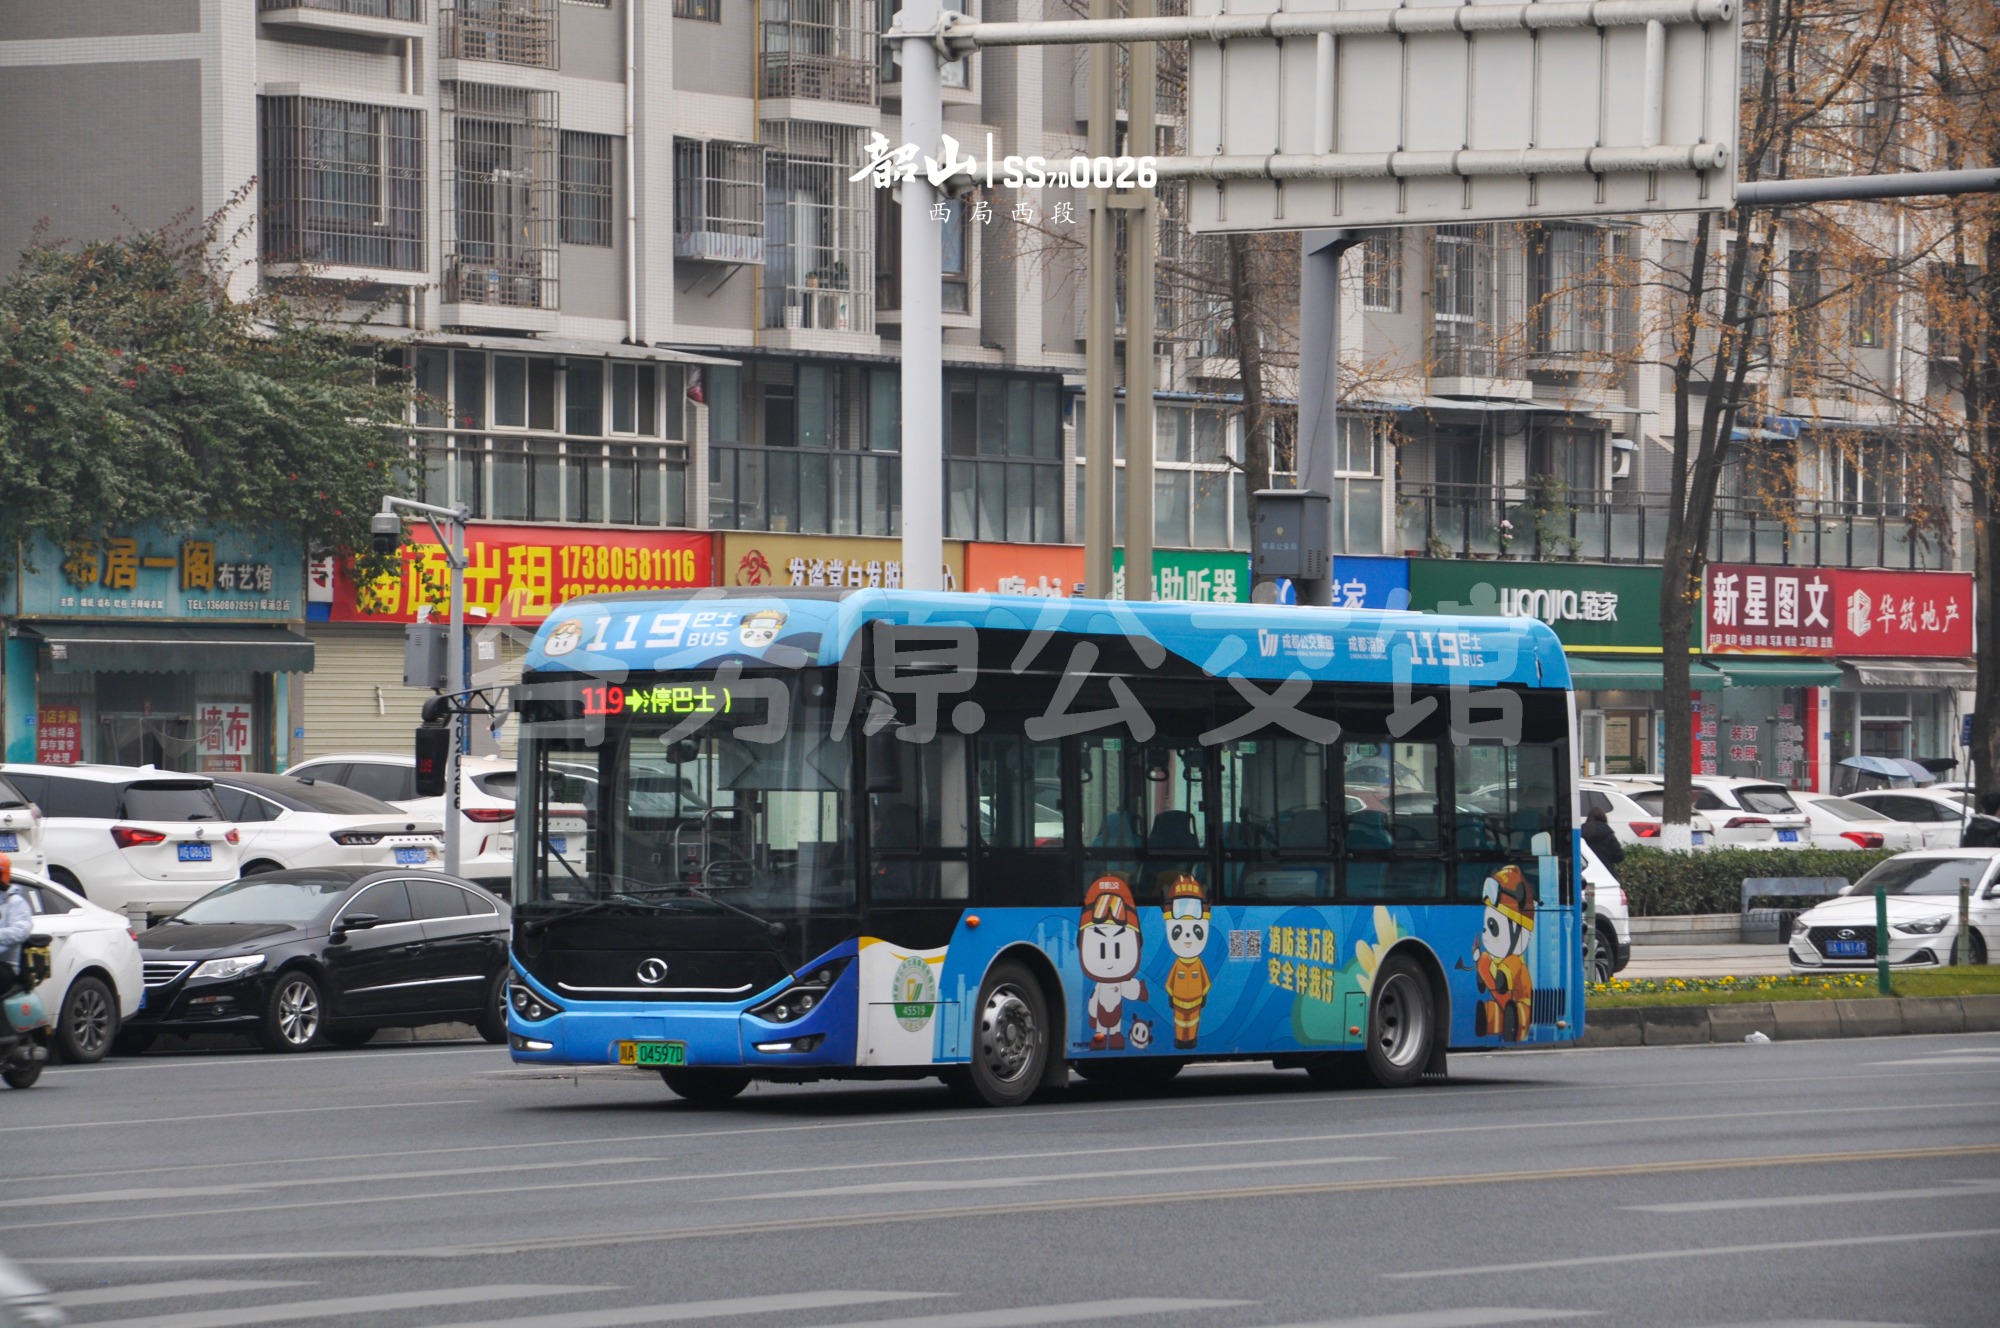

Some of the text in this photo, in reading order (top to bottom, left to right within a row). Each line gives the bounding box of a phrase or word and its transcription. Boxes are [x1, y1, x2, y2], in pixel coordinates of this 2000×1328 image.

[218, 564, 272, 591] 布艺馆
[354, 542, 551, 618] 铺面出租
[559, 546, 695, 582] 17380581116
[1713, 572, 1829, 629] 新星图文
[1876, 594, 1959, 634] 华筑地产
[586, 611, 737, 651] 119 巴士
[686, 631, 730, 647] BUS
[1407, 631, 1482, 666] 119 巴士
[1462, 653, 1484, 667] BUS
[581, 686, 625, 714] 119
[200, 705, 249, 752] 墙布
[1730, 745, 1757, 761] 快照
[1268, 925, 1335, 964] 消防连万路
[1267, 957, 1334, 1003] 安全伴我行
